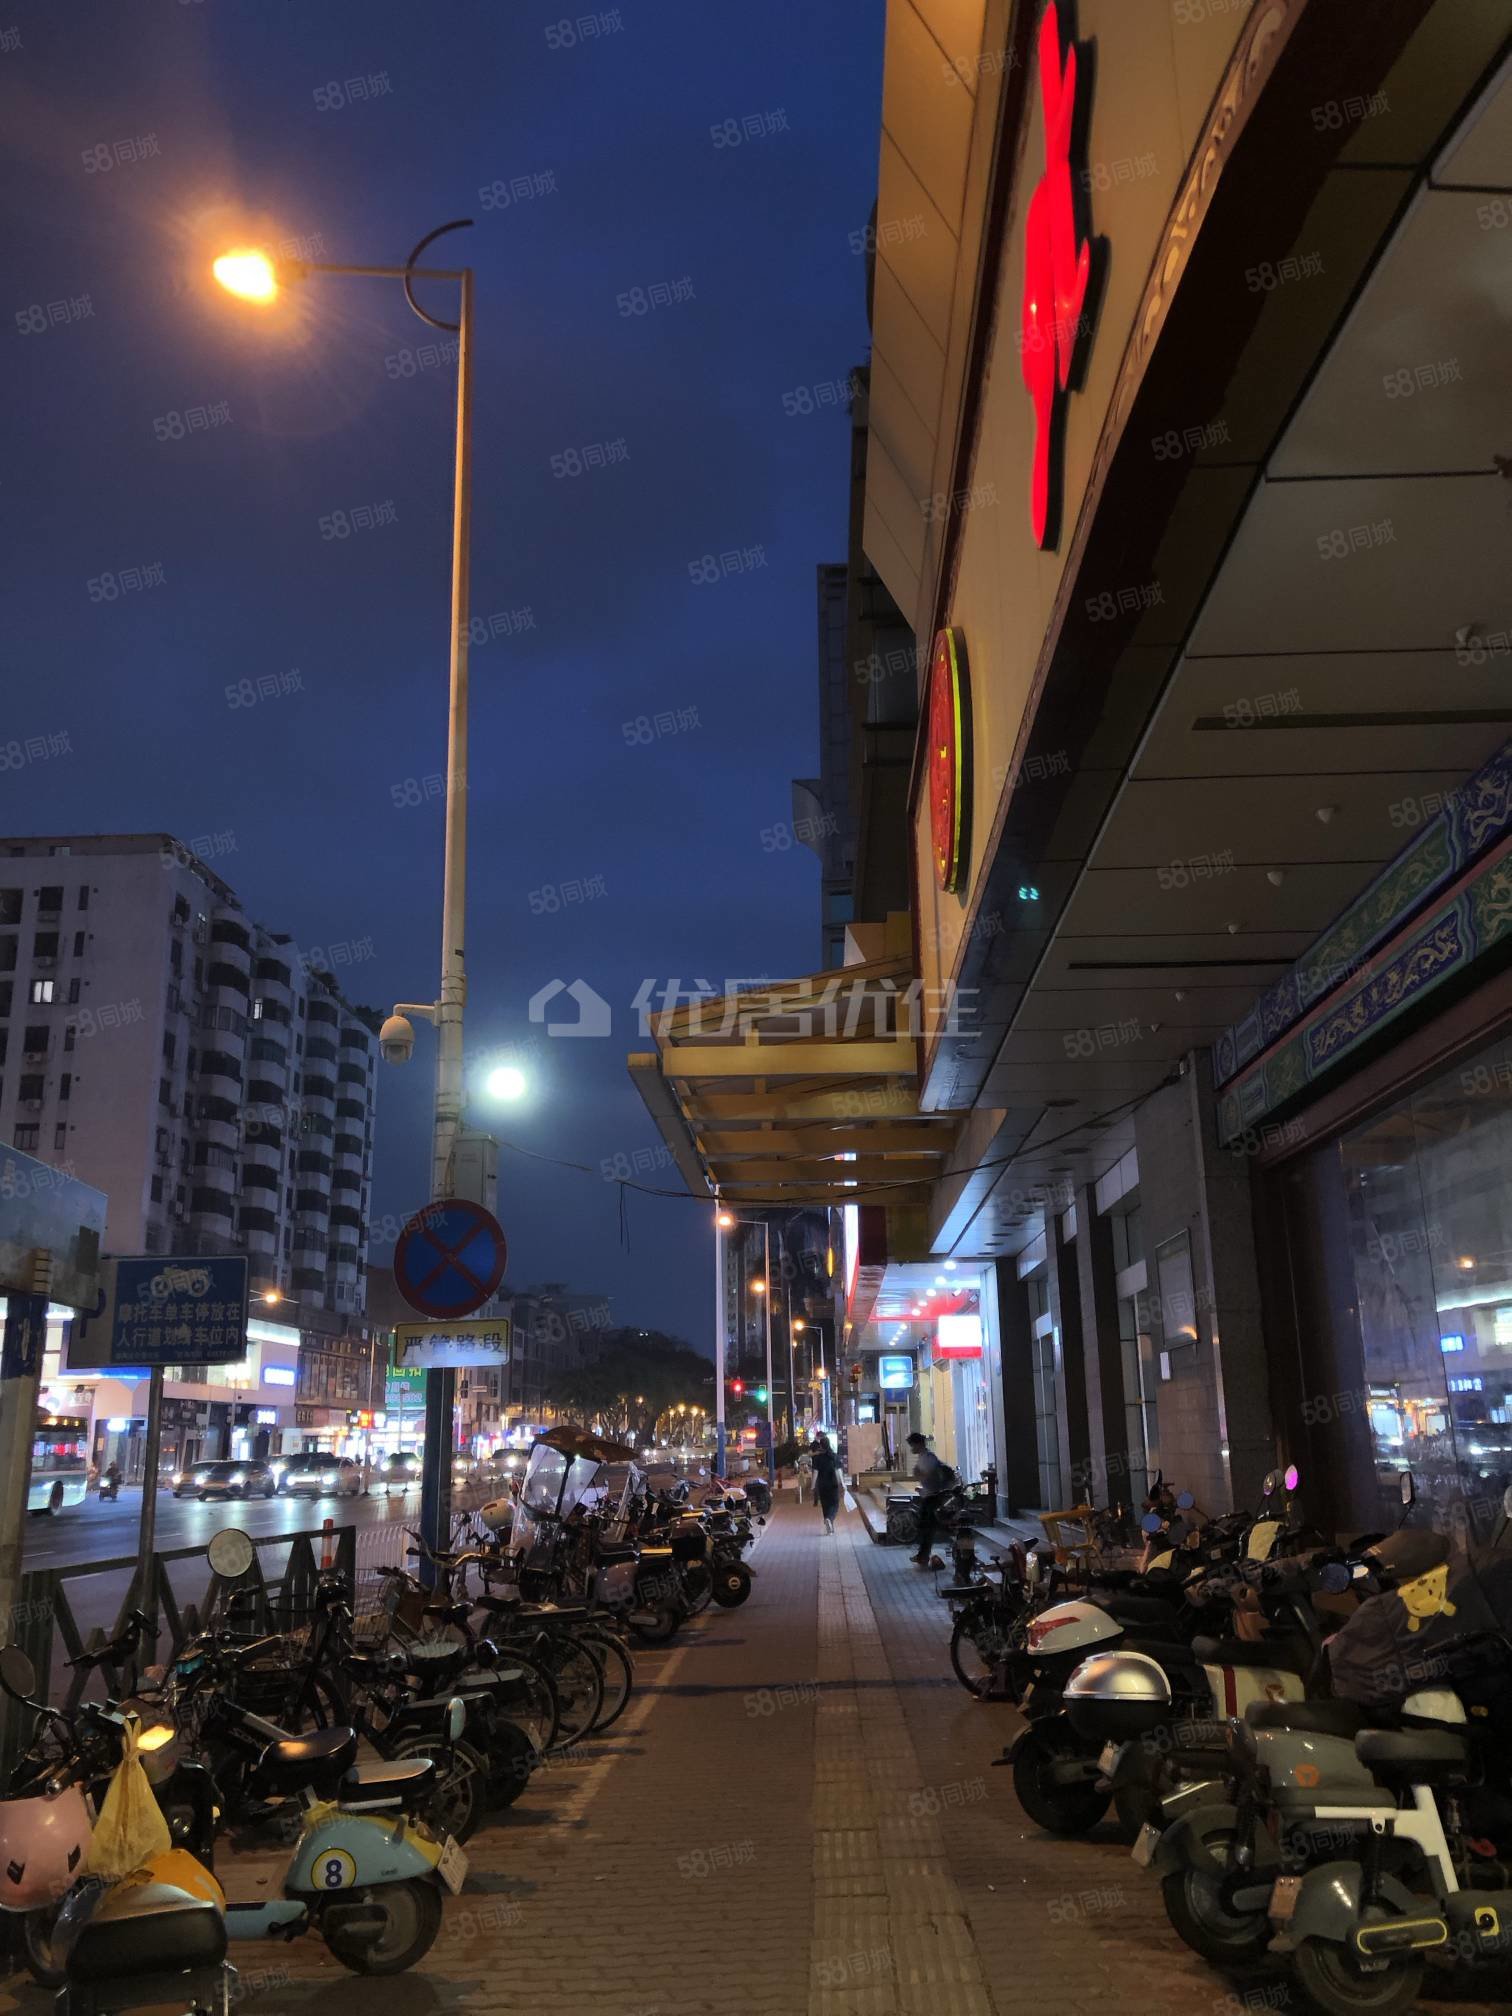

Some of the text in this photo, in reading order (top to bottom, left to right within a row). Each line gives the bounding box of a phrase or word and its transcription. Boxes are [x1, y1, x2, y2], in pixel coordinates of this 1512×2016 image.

[403, 1333, 503, 1357] 严管路段
[325, 1859, 343, 1888] 8
